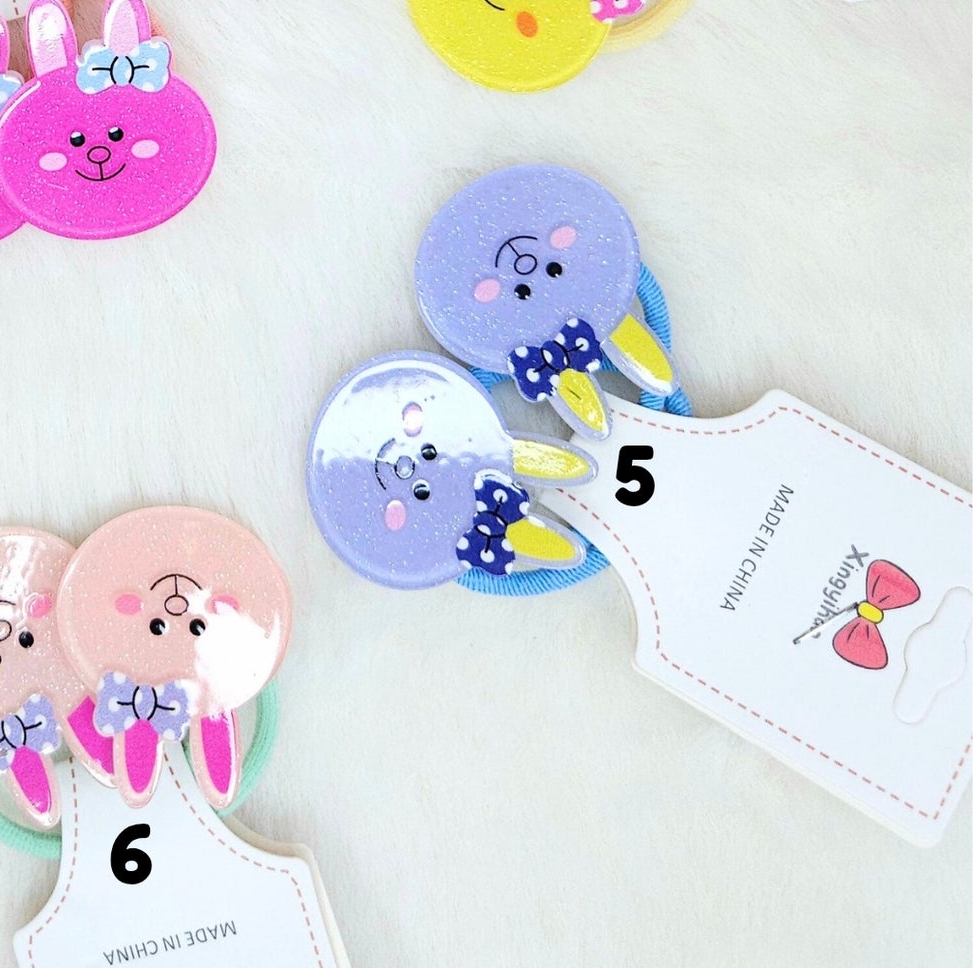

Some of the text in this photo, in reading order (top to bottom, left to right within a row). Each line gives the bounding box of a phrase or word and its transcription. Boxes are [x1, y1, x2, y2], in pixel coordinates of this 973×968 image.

[720, 484, 794, 610] MADE IN CHINA
[103, 921, 236, 965] MADE IN CHINA
